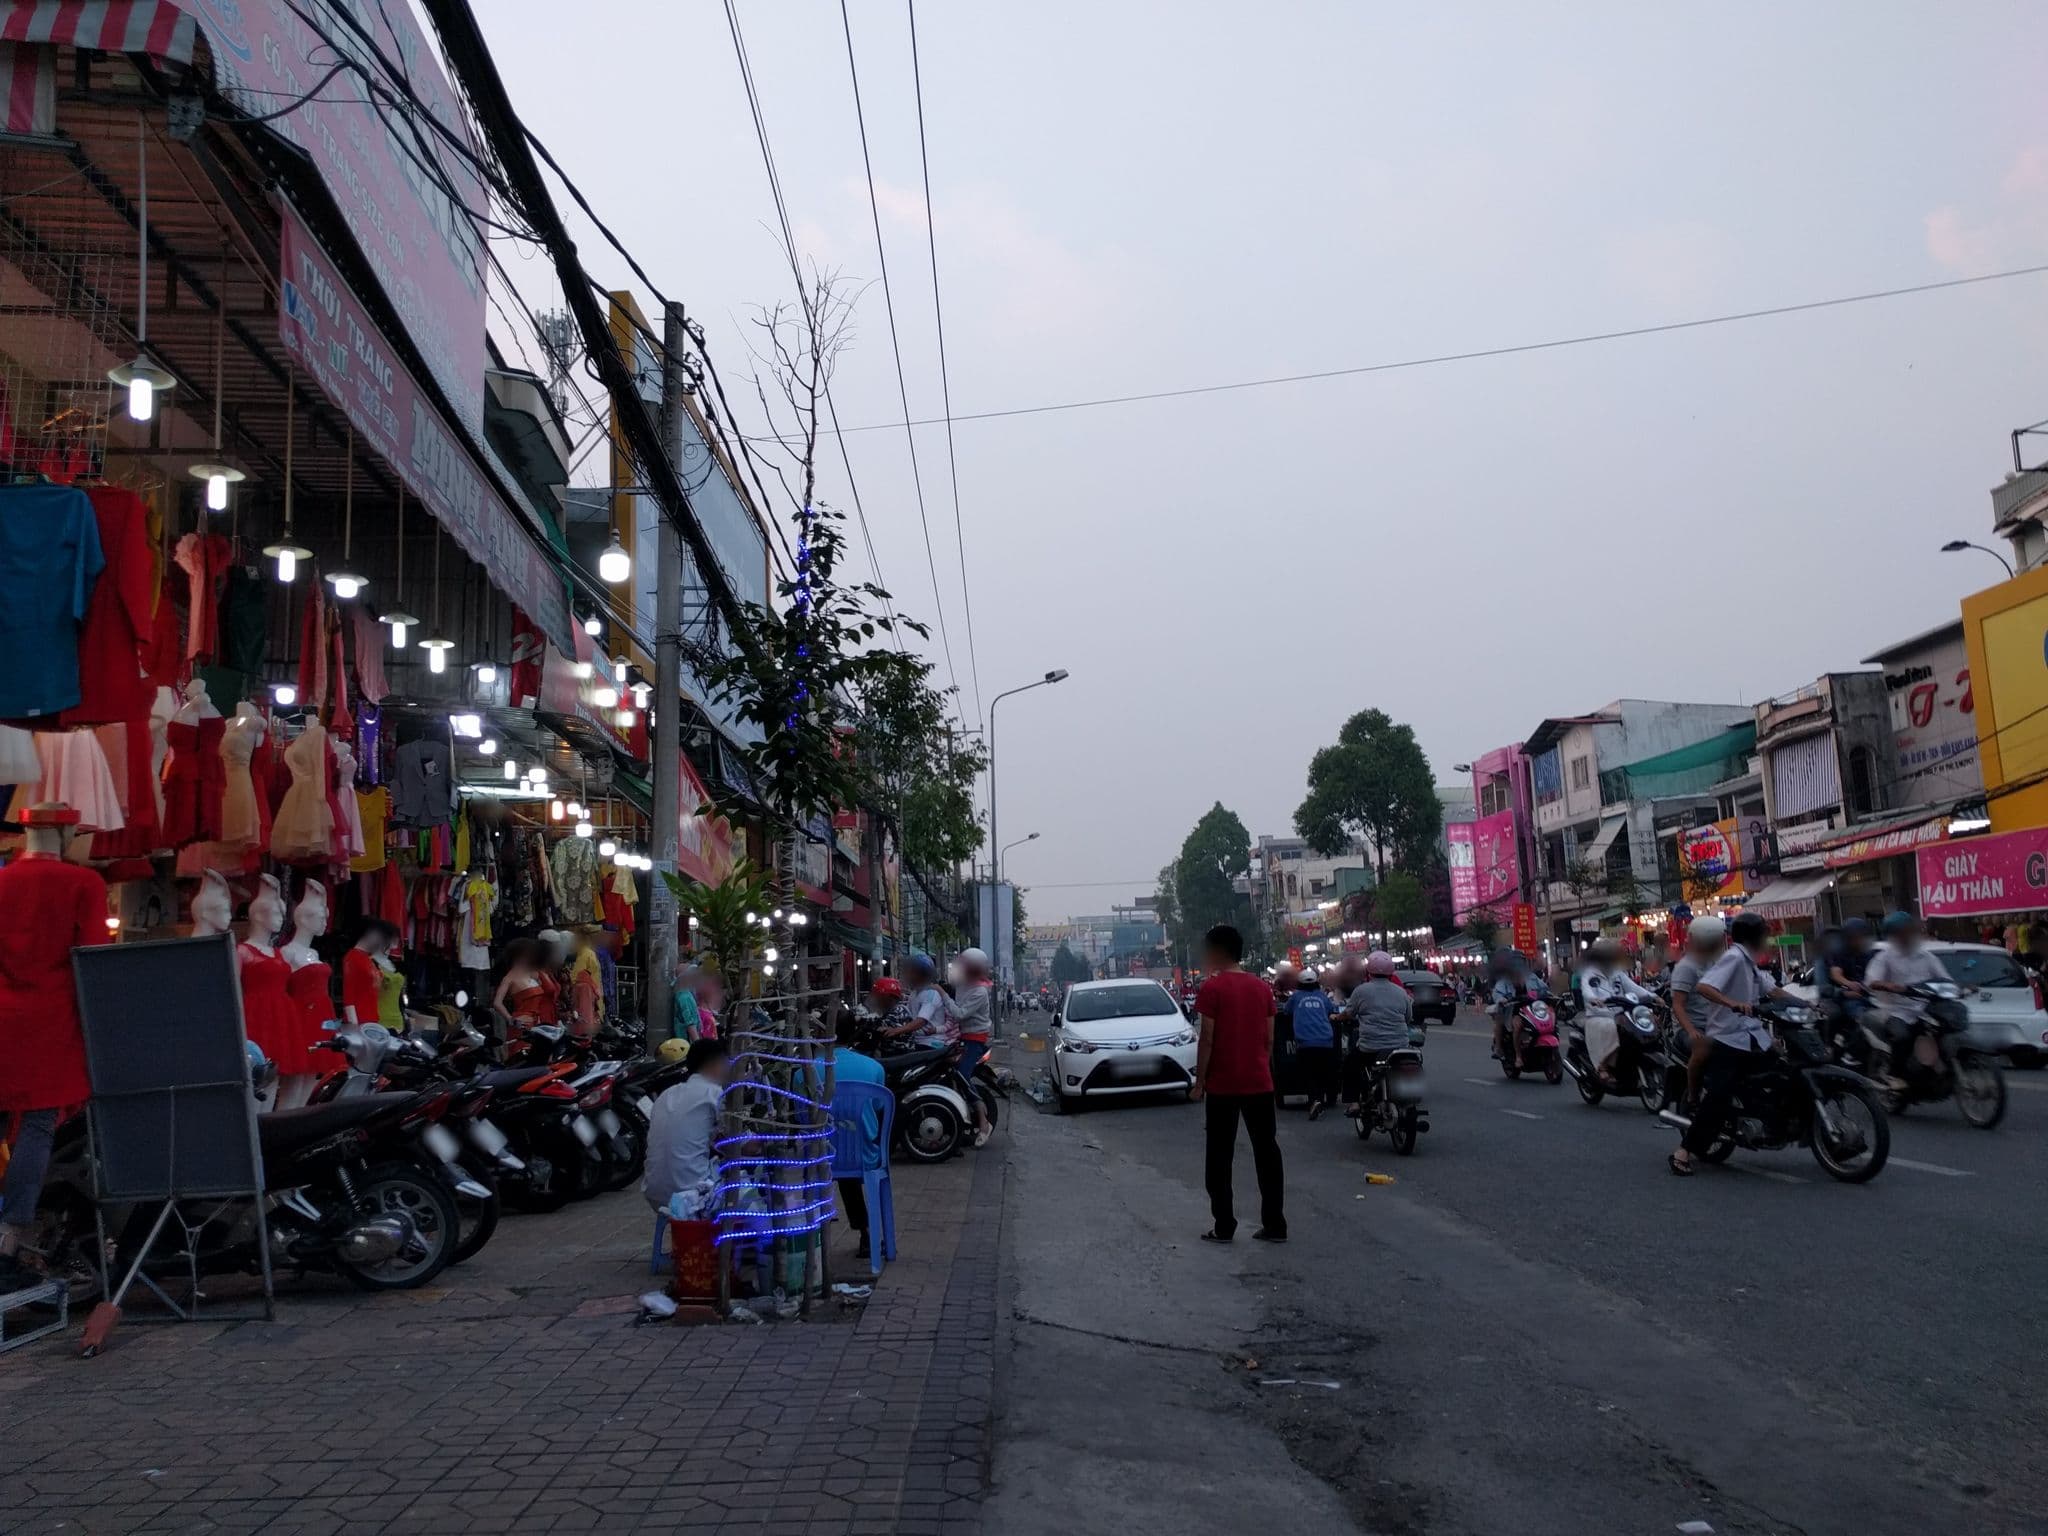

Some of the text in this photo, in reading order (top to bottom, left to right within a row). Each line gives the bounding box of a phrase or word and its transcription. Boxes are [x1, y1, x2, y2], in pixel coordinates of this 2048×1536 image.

[362, 186, 385, 234] SIZE
[299, 249, 342, 328] THỜI
[346, 311, 395, 396] TRANG
[1944, 849, 1979, 879] GIÀY
[1960, 875, 2005, 902] THÂN
